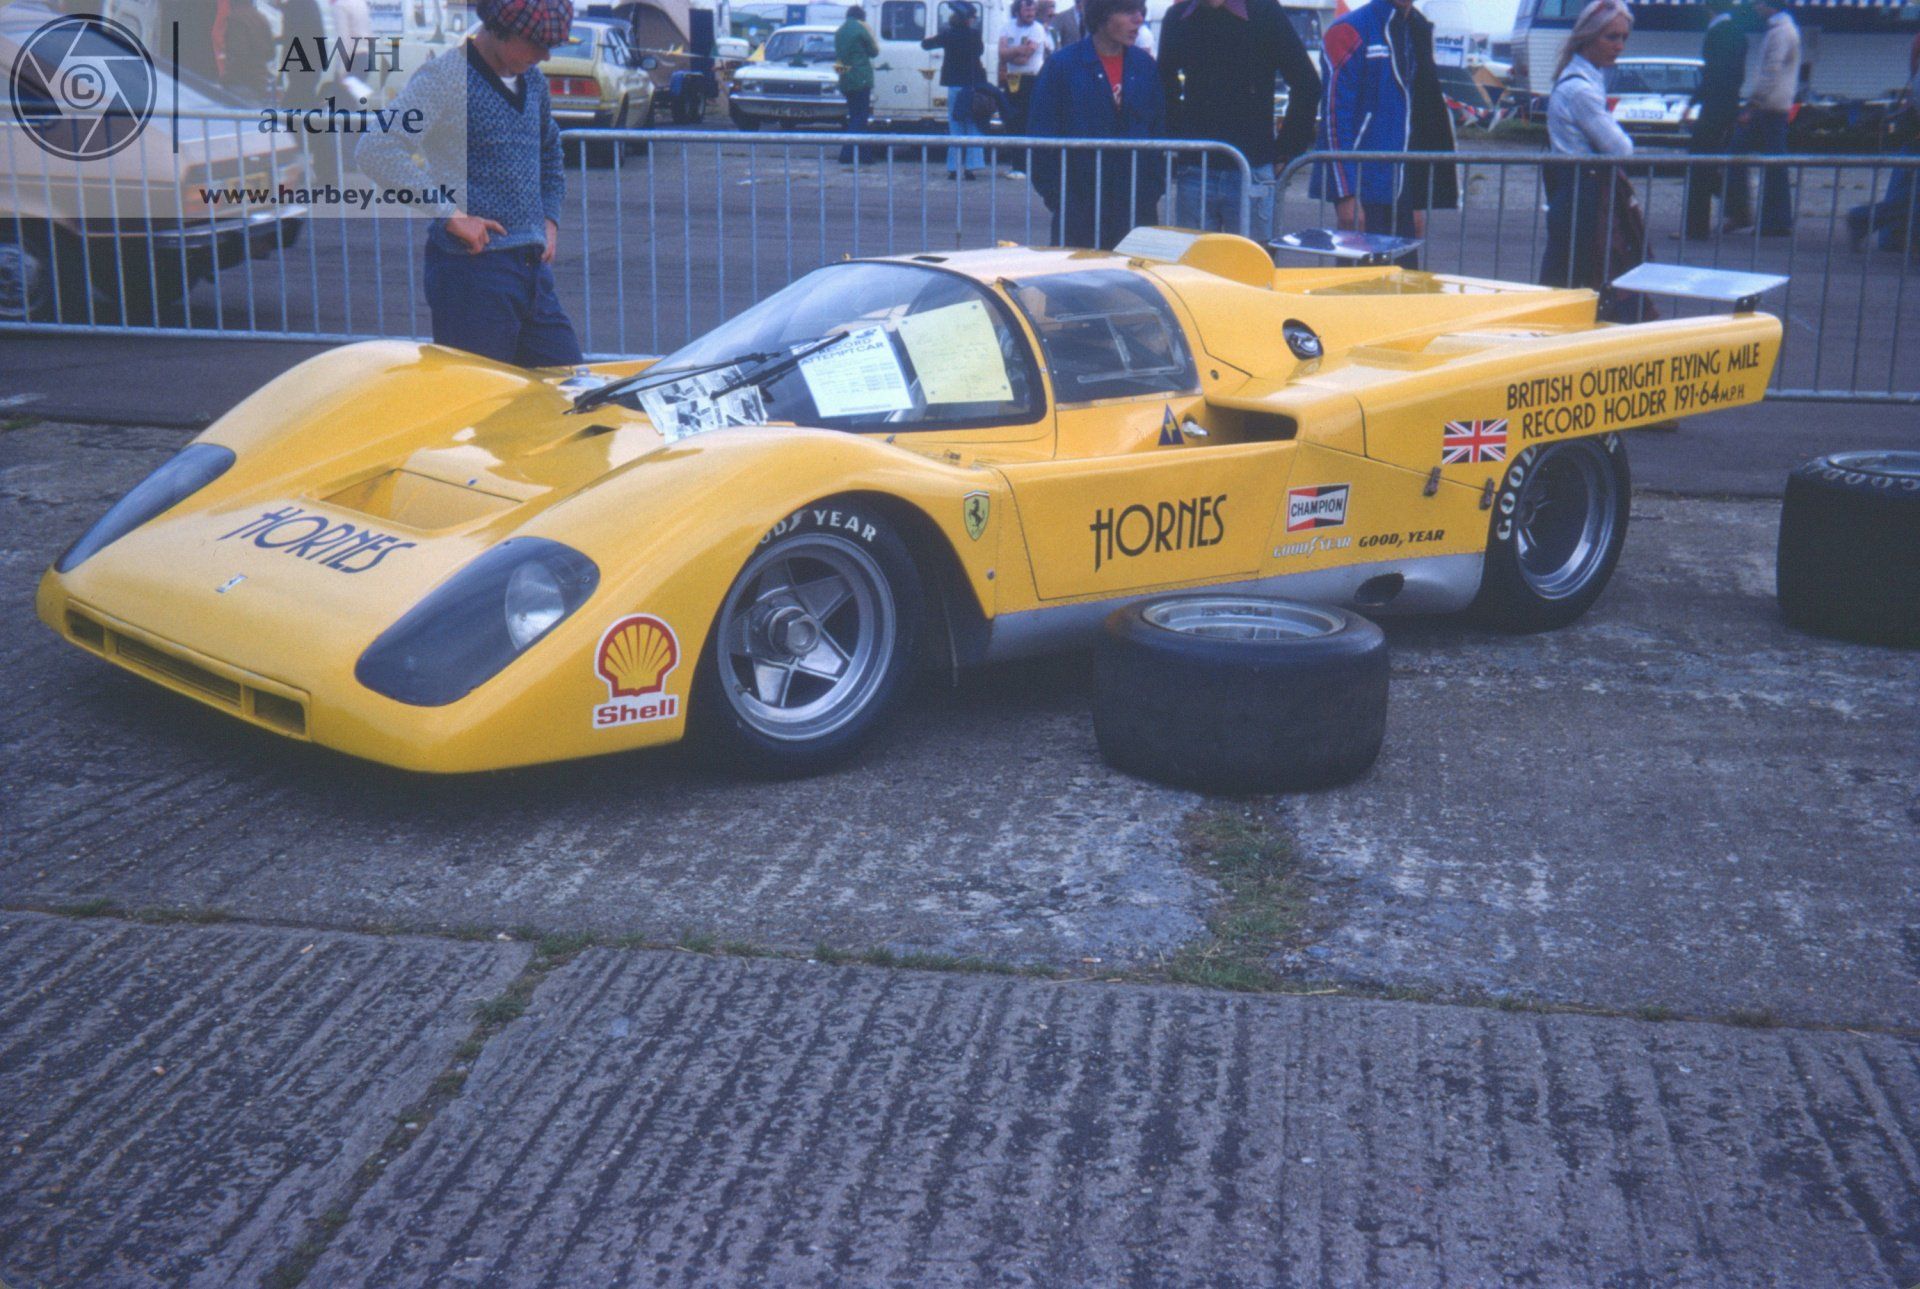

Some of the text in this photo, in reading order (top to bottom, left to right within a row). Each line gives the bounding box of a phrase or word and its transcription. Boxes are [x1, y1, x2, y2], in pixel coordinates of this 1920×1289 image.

[855, 342, 884, 353] CAR
[1507, 342, 1760, 411] BRITISH OUTRIGHT FLYING MILE
[1522, 403, 1596, 440] RECORD
[1603, 388, 1667, 425] HOLDER
[813, 509, 877, 542] YEAR
[1290, 498, 1343, 518] CHAMPION
[216, 506, 417, 573] HORNES
[1089, 493, 1227, 573] HORNES
[597, 698, 675, 725] Shell
